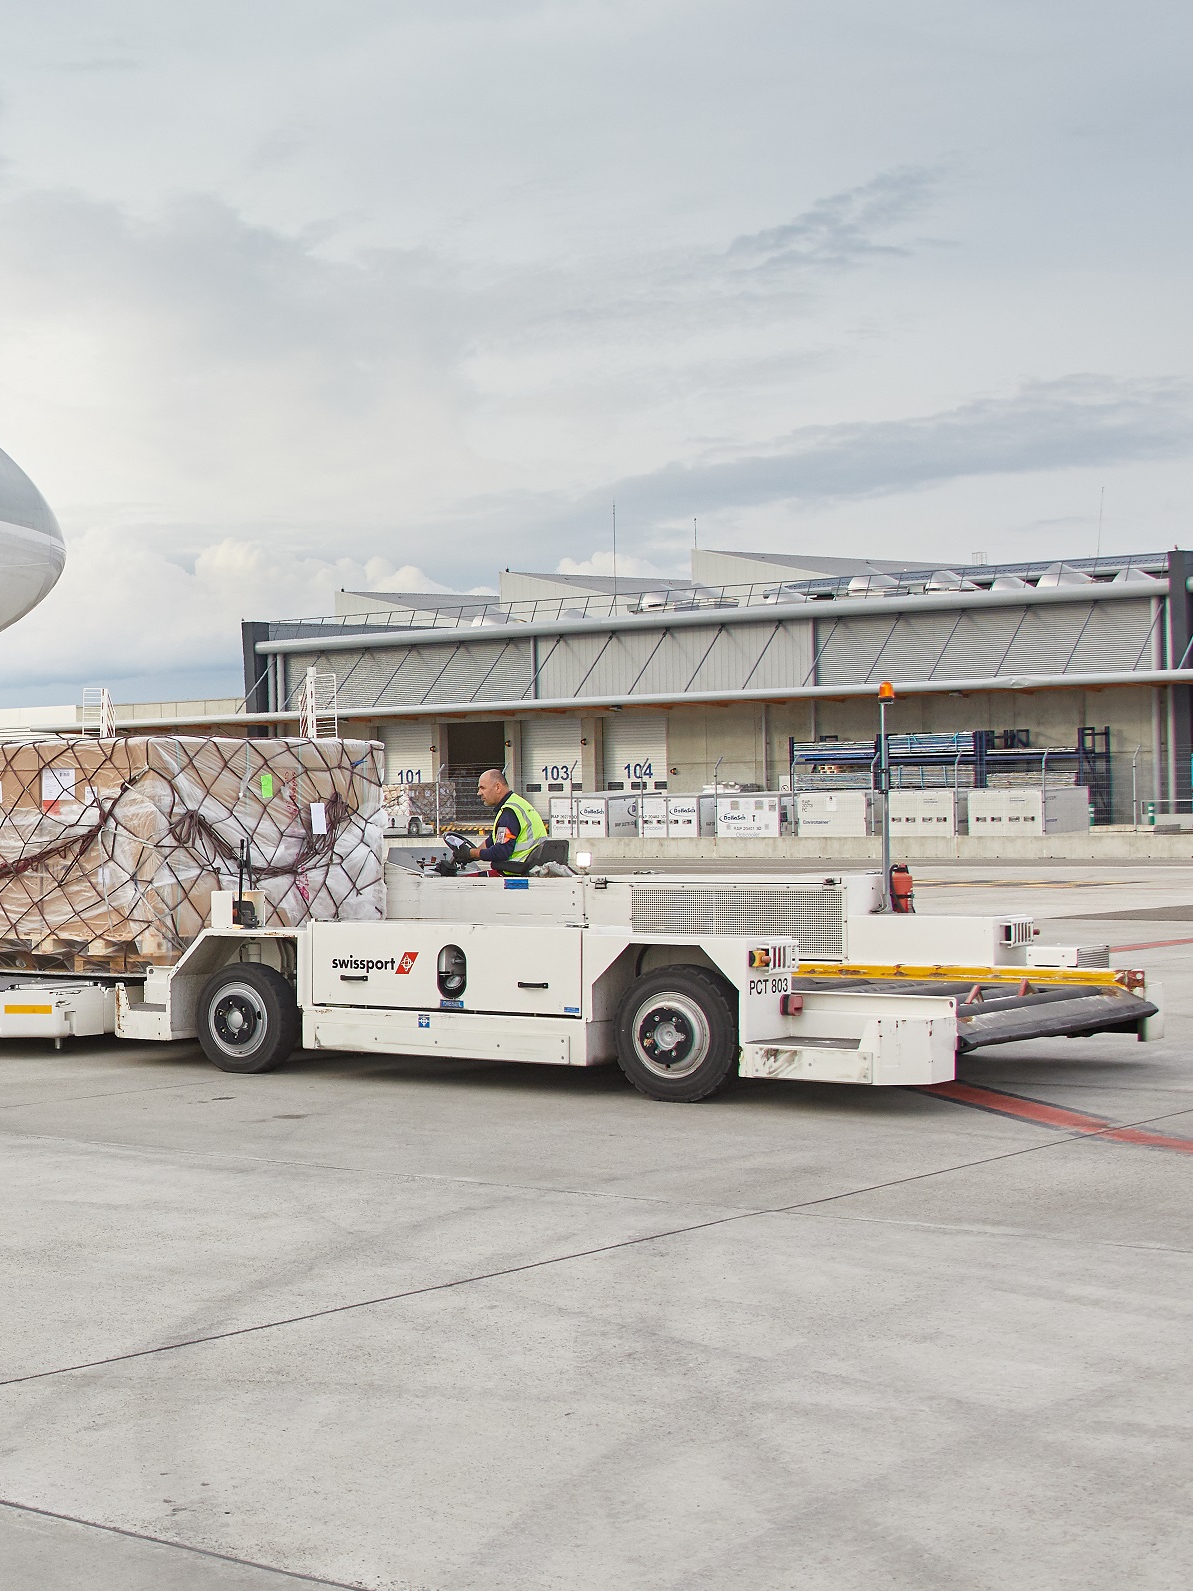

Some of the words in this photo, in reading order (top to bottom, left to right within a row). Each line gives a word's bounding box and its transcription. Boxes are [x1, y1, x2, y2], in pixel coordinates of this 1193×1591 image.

[397, 769, 422, 784] 101
[541, 765, 570, 781] 103
[624, 763, 653, 779] 104
[331, 954, 396, 974] swissport
[749, 979, 769, 995] PCT
[771, 978, 788, 993] 803
